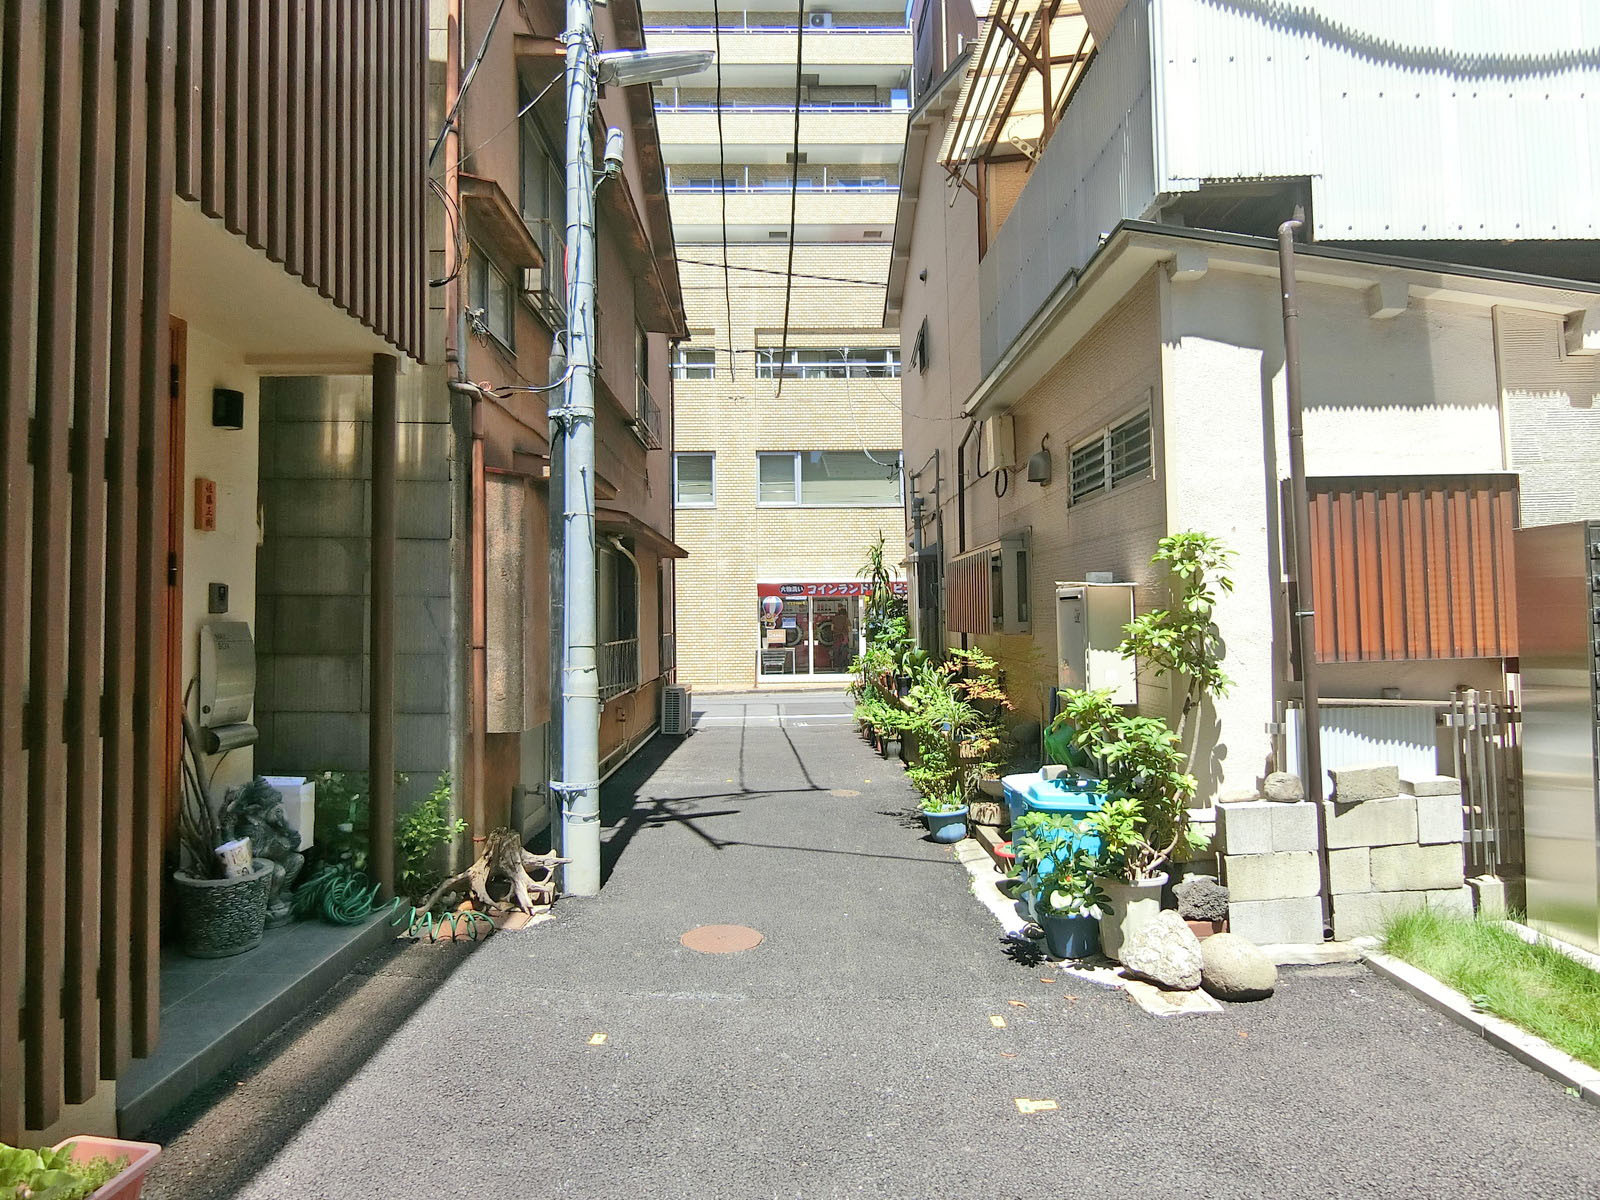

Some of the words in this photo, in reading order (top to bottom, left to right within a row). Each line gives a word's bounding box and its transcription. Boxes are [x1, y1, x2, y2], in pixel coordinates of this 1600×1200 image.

[807, 584, 873, 594] コインランド
